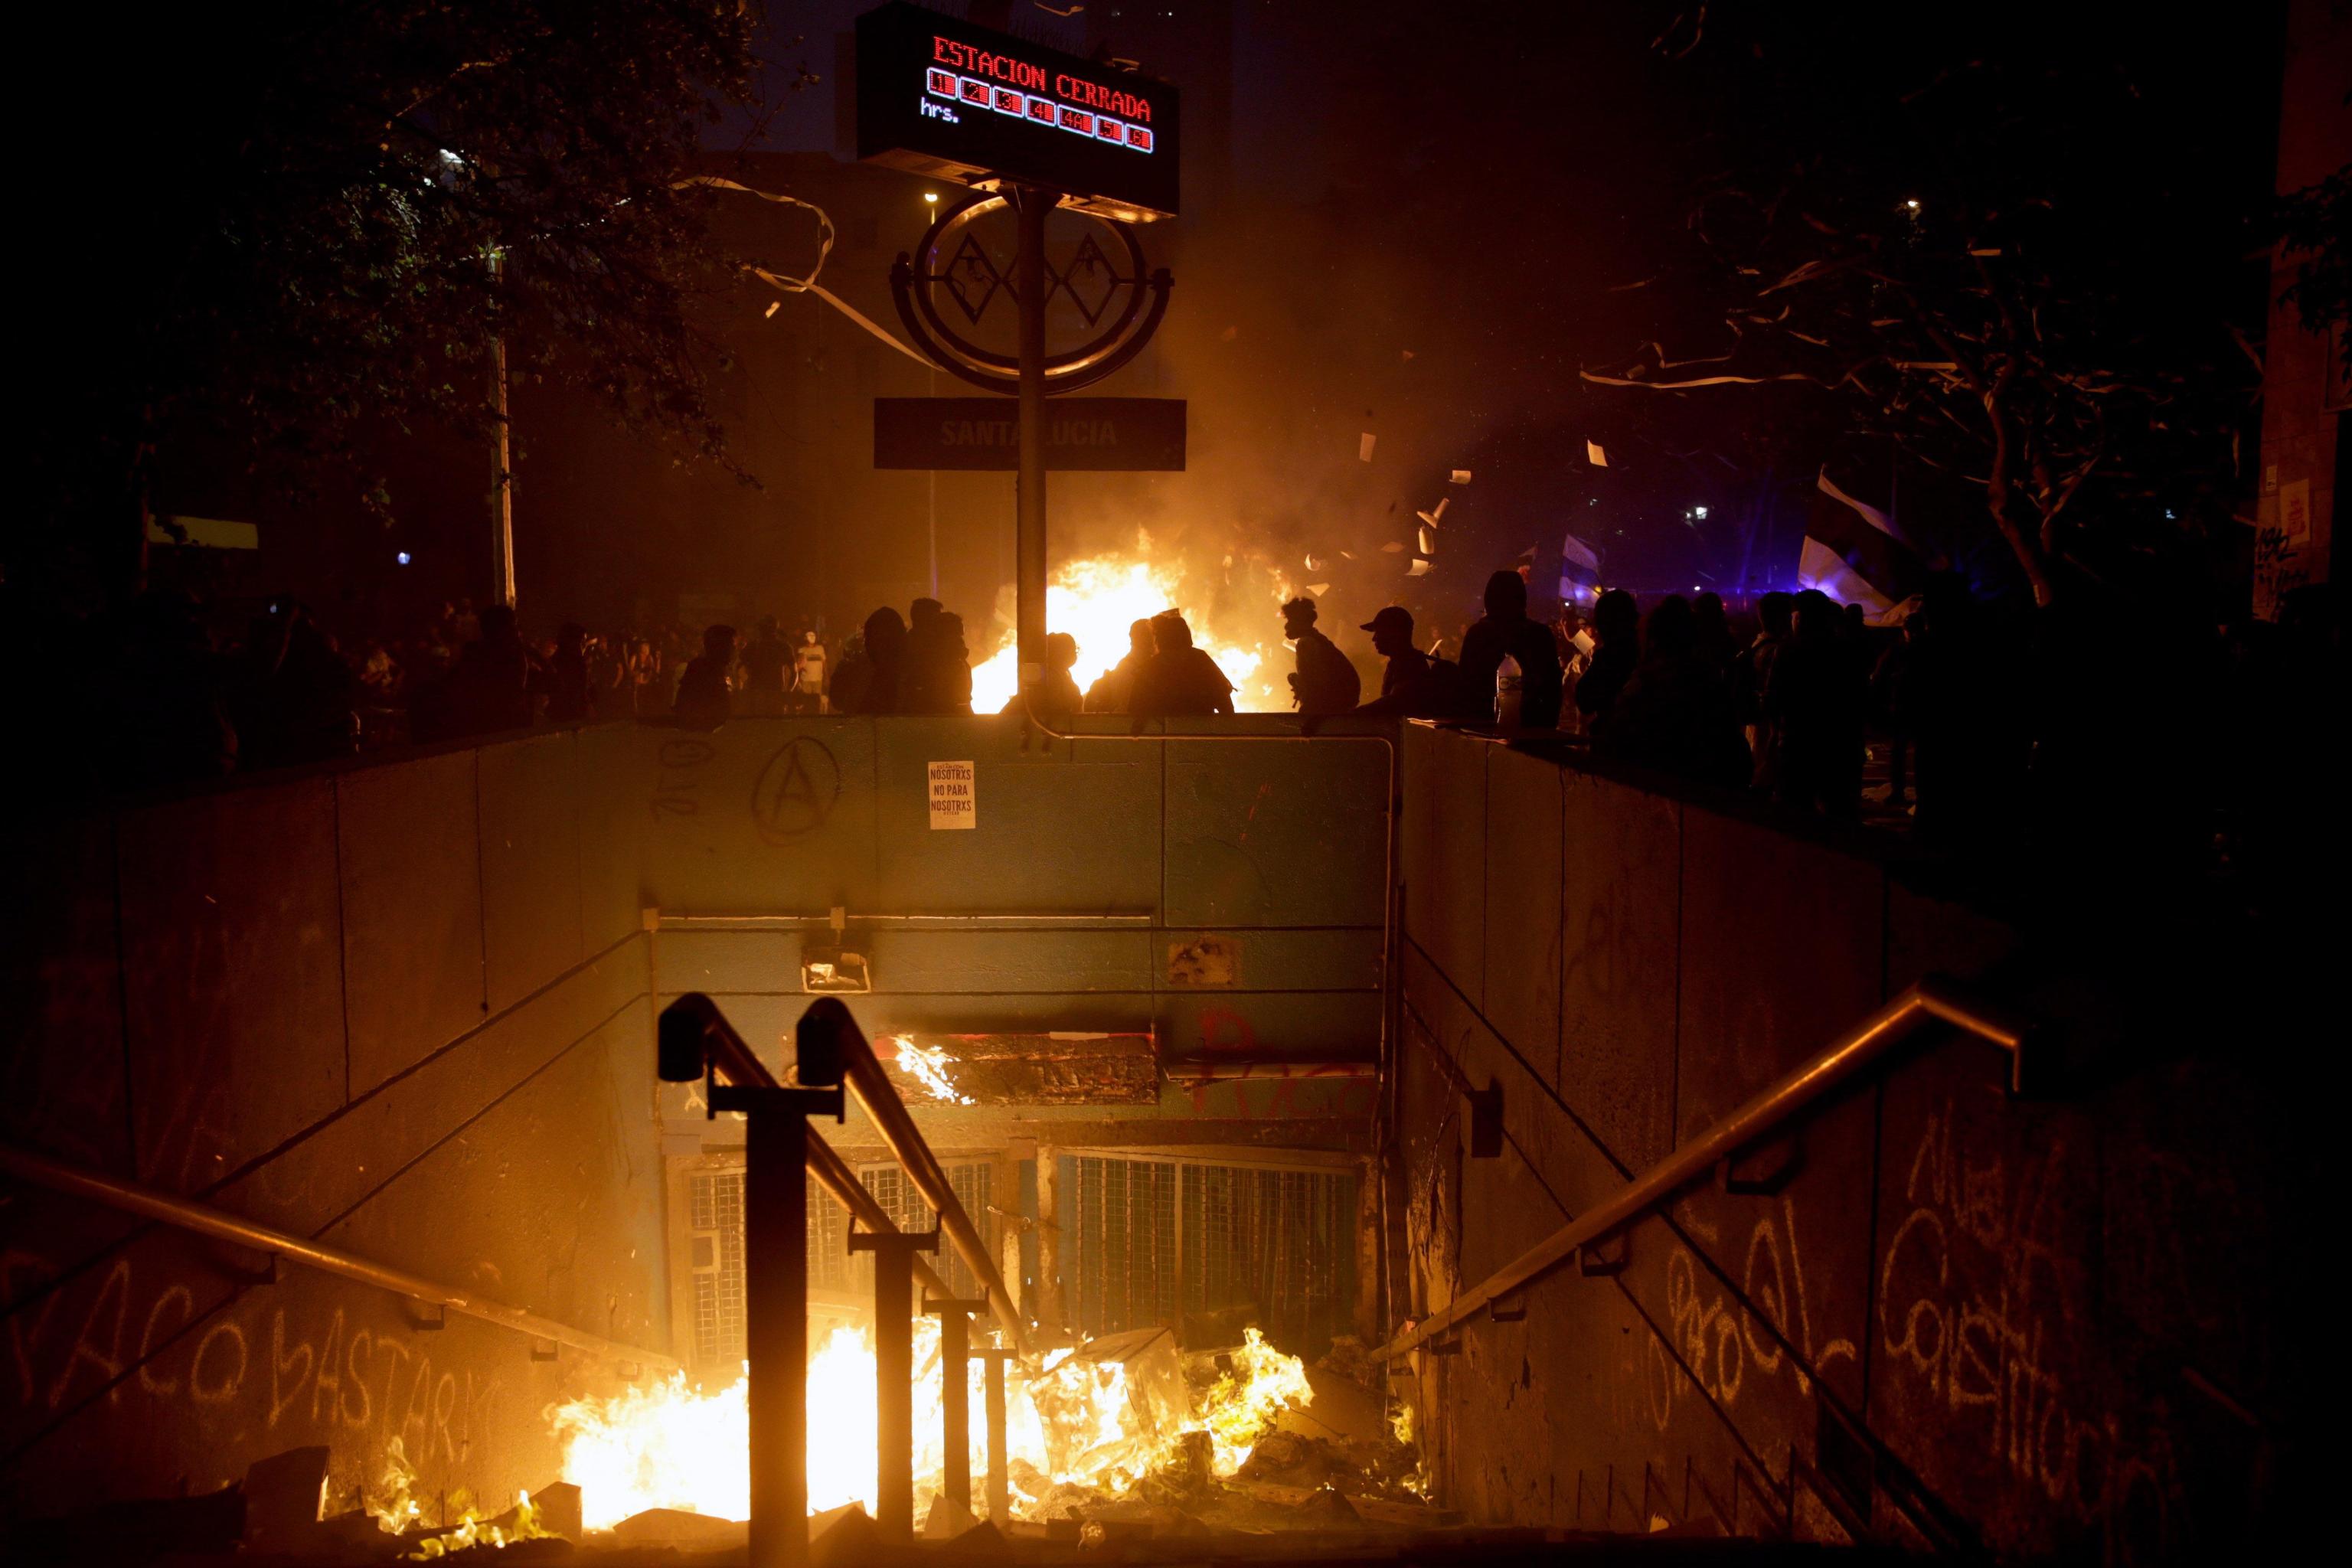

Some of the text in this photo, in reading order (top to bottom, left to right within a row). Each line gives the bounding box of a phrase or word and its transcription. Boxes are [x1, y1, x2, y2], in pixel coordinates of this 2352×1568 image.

[933, 36, 1152, 122] ESTACION CERRADA
[920, 96, 959, 123] hrs.
[1045, 420, 1117, 446] UCIA
[930, 769, 972, 780] NOSOTRXS
[934, 785, 968, 796] NO PARA
[930, 800, 972, 812] NOSOTRXS
